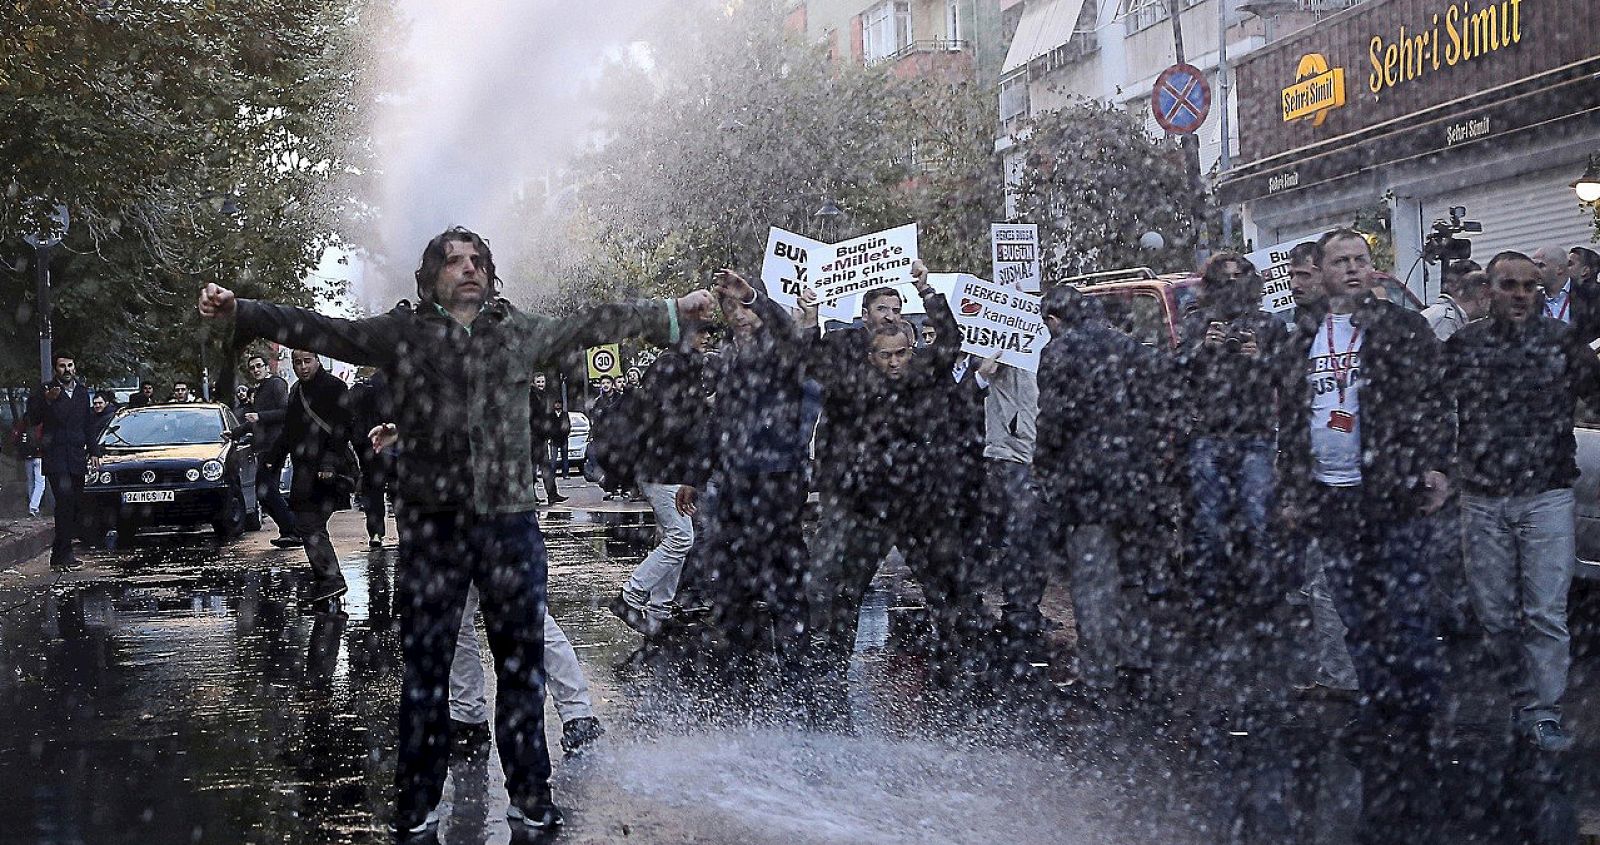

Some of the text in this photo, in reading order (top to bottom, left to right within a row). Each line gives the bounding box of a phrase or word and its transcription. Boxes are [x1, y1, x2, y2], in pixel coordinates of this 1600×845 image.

[1369, 0, 1522, 103] Şehr-i Simit
[1284, 77, 1332, 117] Şehr-i Simit
[1469, 116, 1490, 137] Simit
[834, 246, 903, 271] Millet'e
[836, 237, 887, 258] Bugün
[1002, 244, 1033, 261] BUGÜN
[814, 257, 911, 289] sahip çıkma
[999, 260, 1034, 286] SUSMAZ
[825, 276, 901, 298] zamanı...
[963, 283, 1042, 316] HERKES SUSS
[957, 323, 1035, 354] SUSMAZ
[597, 356, 610, 367] 30
[127, 492, 138, 502] 34
[161, 491, 173, 501] 74
